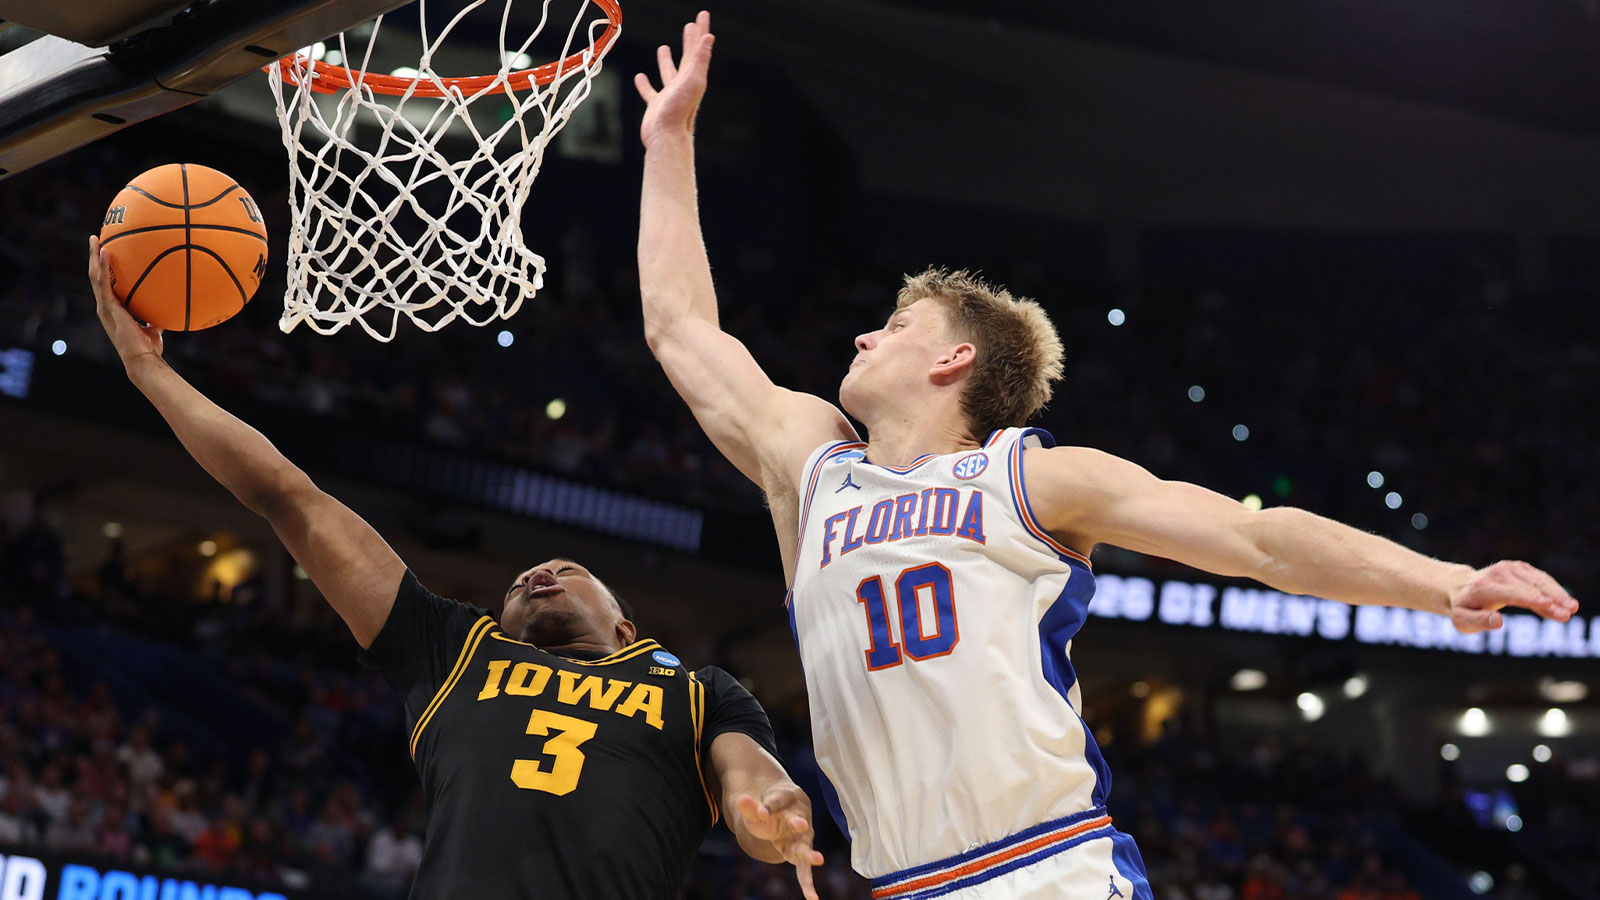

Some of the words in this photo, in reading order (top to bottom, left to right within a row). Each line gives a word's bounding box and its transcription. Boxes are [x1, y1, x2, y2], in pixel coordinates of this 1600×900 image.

[956, 454, 986, 478] SEC
[820, 487, 986, 569] FLORIDA
[856, 561, 960, 672] 10
[1088, 574, 1155, 621] 26
[1158, 580, 1217, 627] DI
[1219, 586, 1349, 640] MEN'S
[477, 660, 665, 731] IOWA
[510, 708, 599, 797] 3
